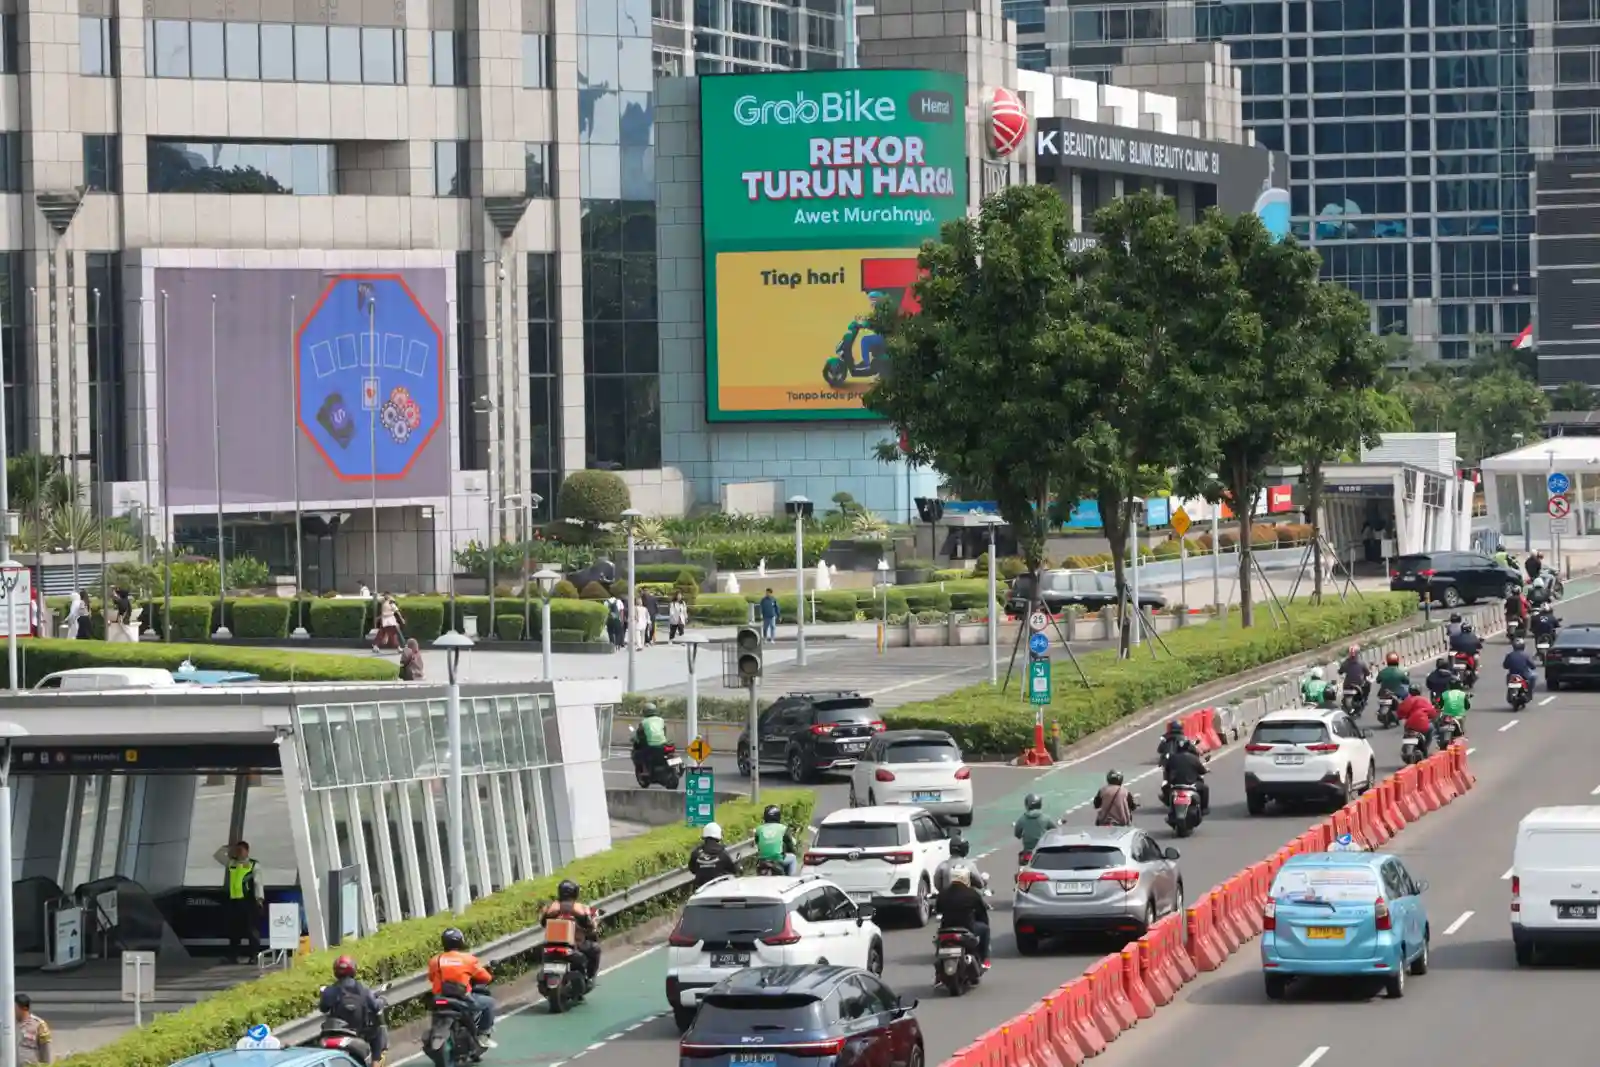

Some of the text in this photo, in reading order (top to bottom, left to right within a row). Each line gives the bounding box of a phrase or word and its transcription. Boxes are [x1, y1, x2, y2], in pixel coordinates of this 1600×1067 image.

[734, 89, 896, 126] GrabBike
[809, 136, 925, 166] REKOR
[1037, 130, 1059, 156] K
[1063, 131, 1099, 159] BEAUTY
[1099, 137, 1126, 163] CLINIC
[1129, 140, 1153, 167] BLINK
[1154, 144, 1185, 171] BEAUTY
[1185, 147, 1209, 173] CLINIC
[742, 166, 954, 200] TURUN HARGA
[794, 205, 935, 226] Awet Murahnya.
[760, 266, 845, 289] Tiap hari
[787, 391, 819, 403] Tanpa
[1032, 616, 1044, 624] 25
